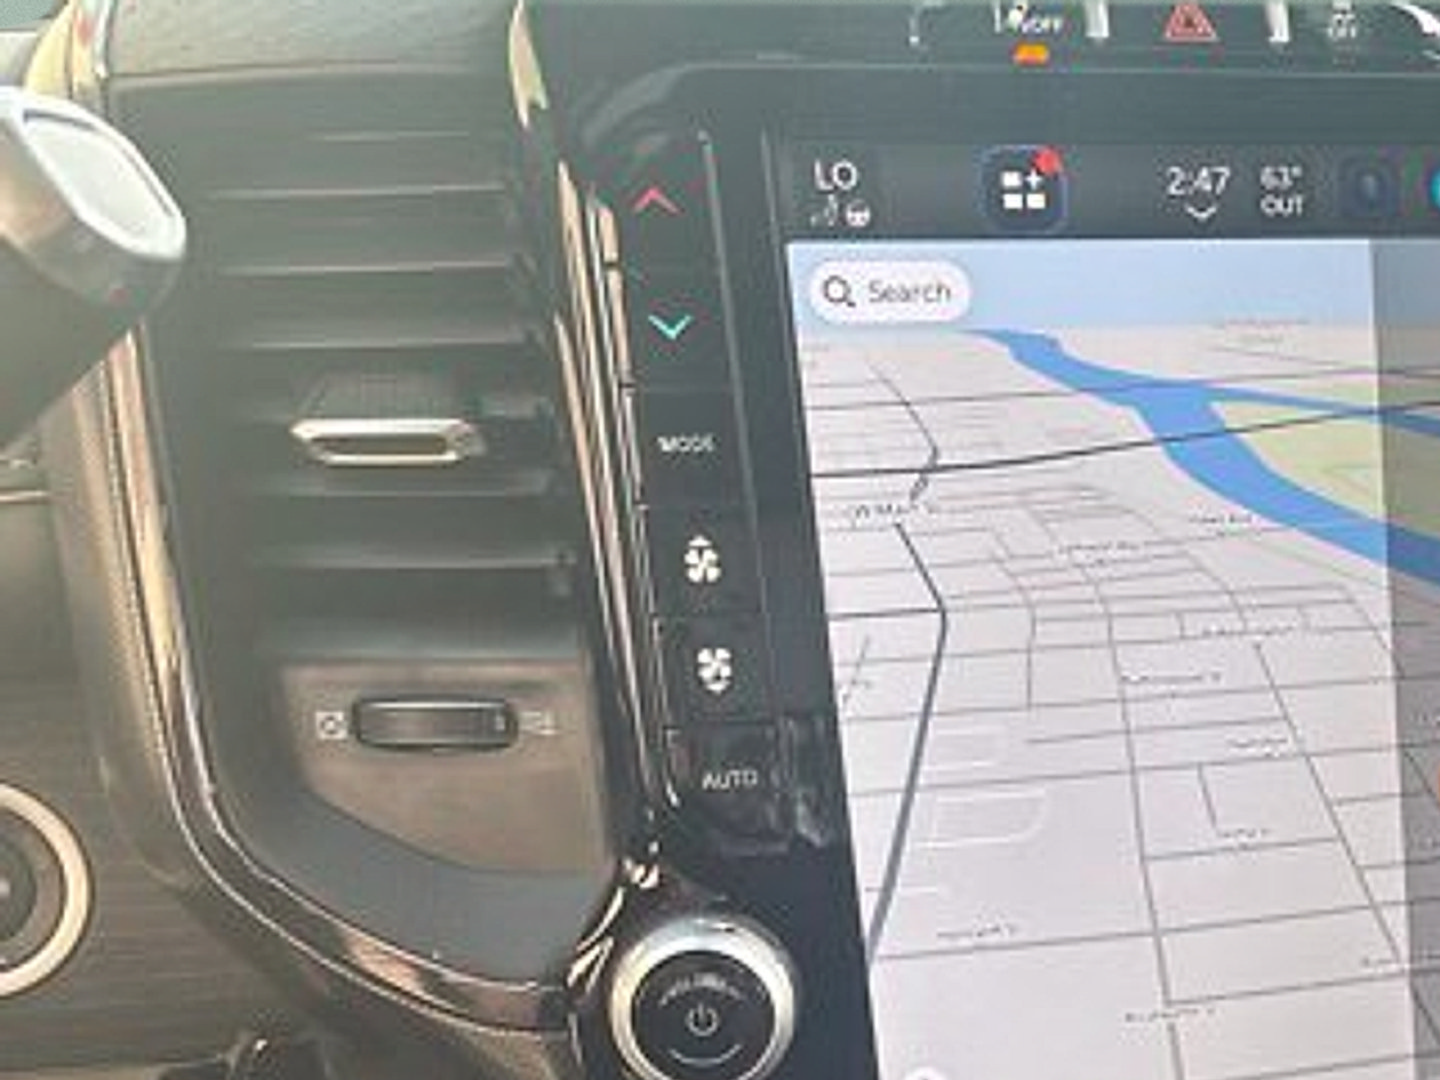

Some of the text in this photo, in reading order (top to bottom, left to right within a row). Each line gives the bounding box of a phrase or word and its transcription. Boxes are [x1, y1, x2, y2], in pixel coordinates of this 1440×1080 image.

[814, 159, 858, 191] LO
[1166, 166, 1231, 196] 2:47
[1260, 165, 1303, 191] 63°
[1260, 194, 1303, 217] OUT
[867, 279, 952, 303] Search
[656, 434, 716, 452] MODE
[702, 769, 758, 790] AUTO
